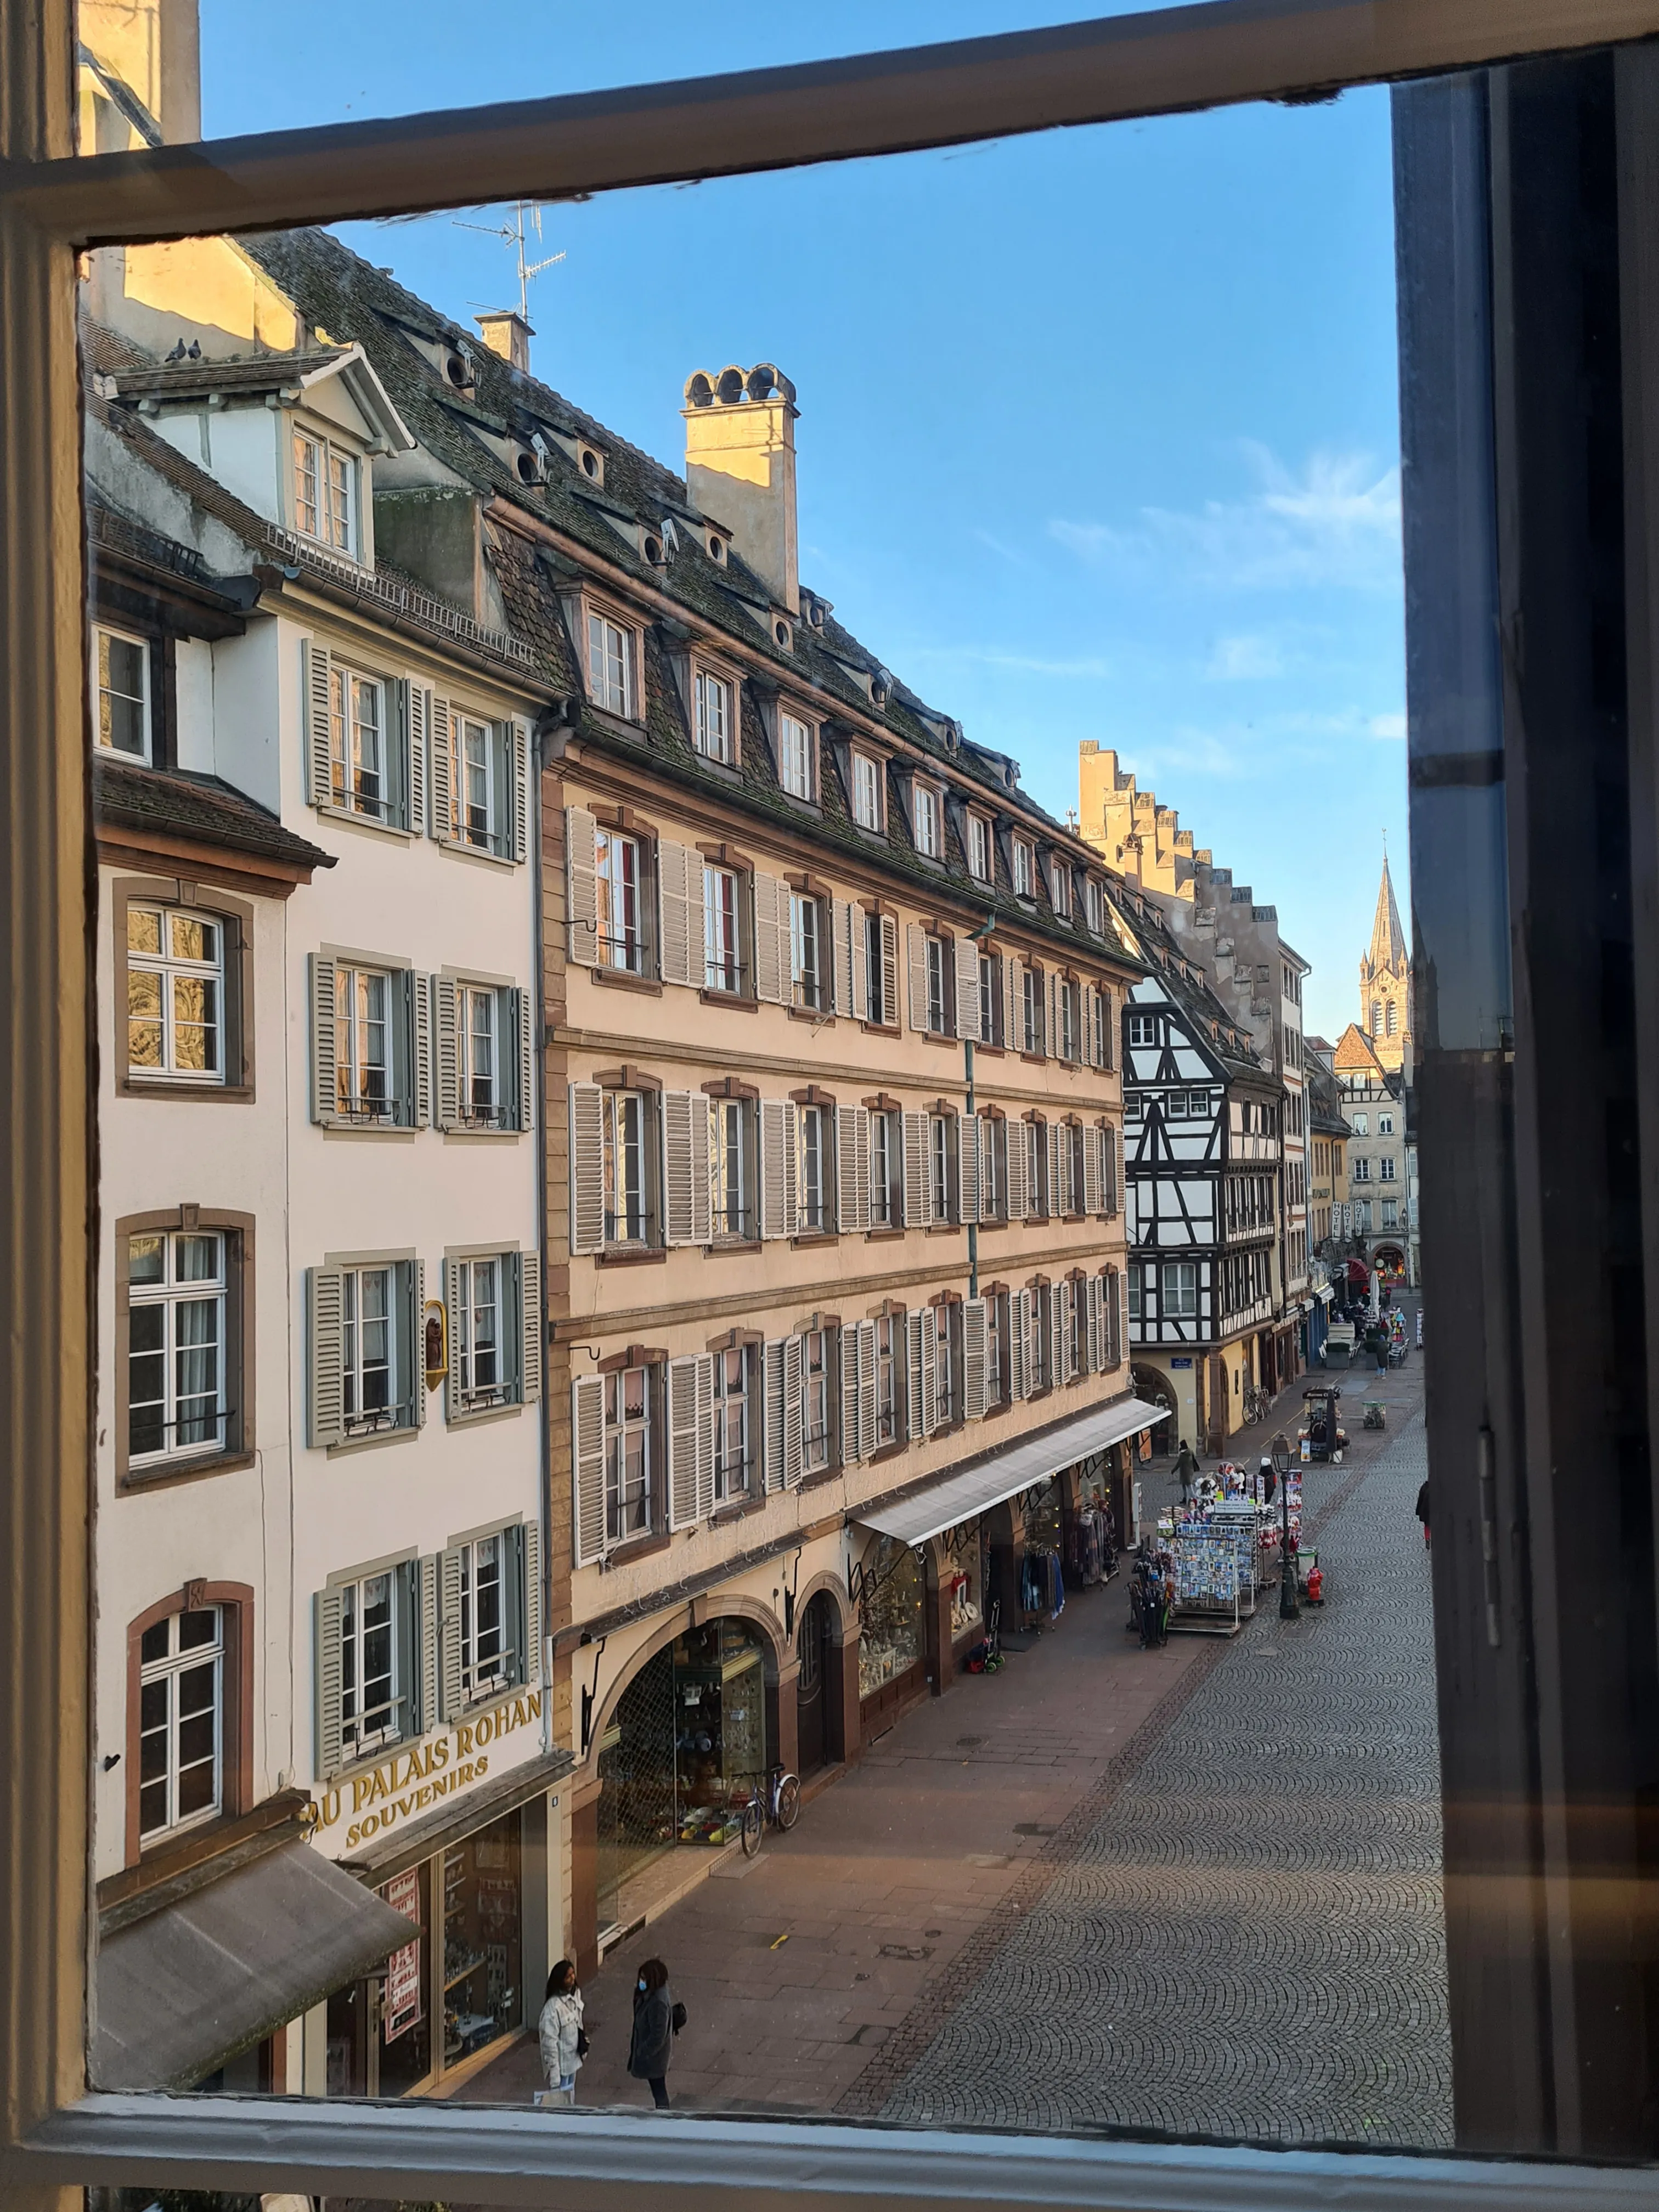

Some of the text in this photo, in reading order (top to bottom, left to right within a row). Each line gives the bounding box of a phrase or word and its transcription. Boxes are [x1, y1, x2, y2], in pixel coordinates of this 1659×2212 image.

[346, 1756, 488, 1849] SOUVENIRS
[352, 1736, 449, 1814] PALAIS
[456, 1690, 542, 1760] ROHAN
